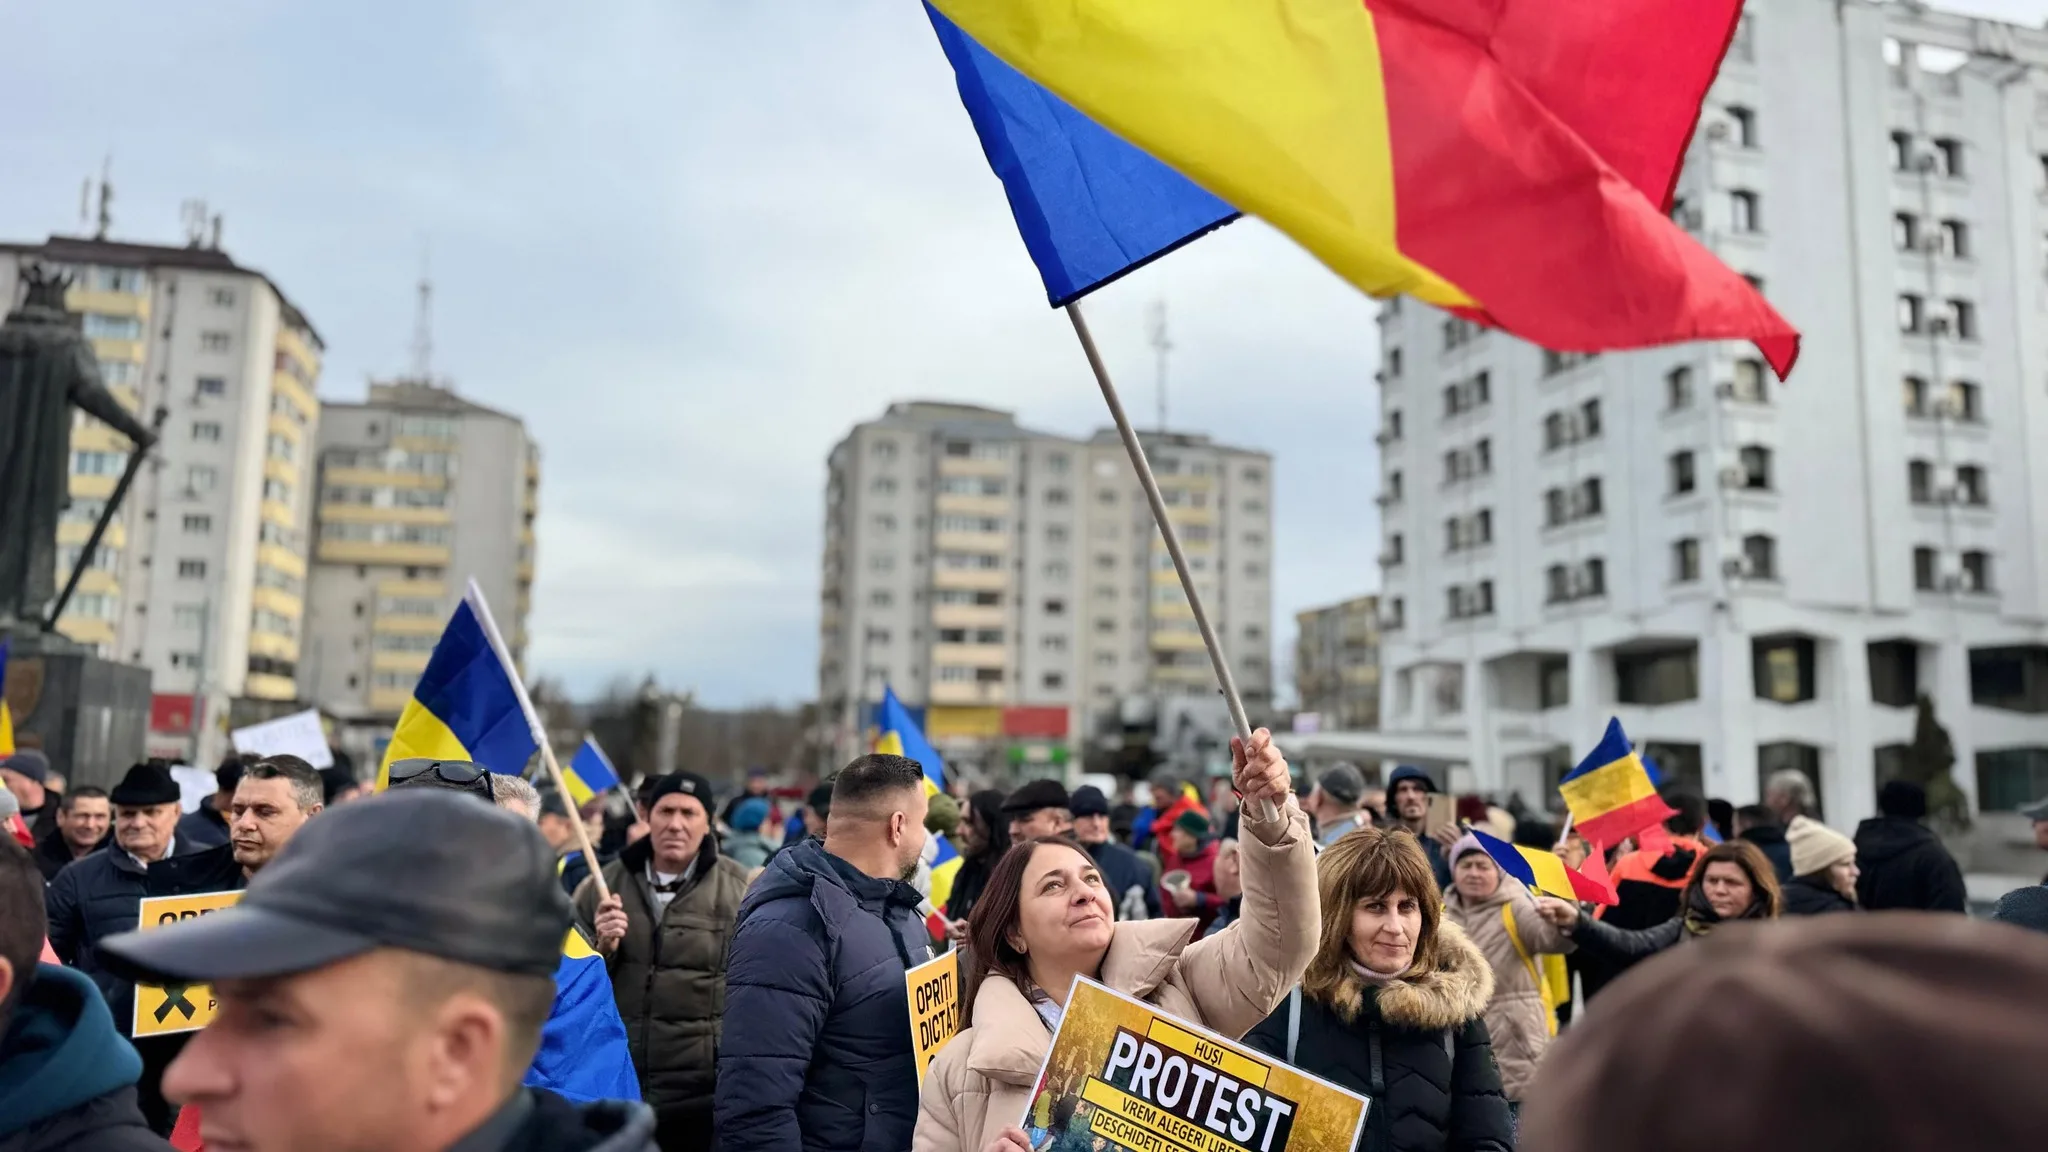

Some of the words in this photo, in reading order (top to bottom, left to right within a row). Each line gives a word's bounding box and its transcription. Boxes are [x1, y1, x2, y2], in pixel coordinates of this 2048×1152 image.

[920, 1001, 959, 1051] DICTAT
[1104, 1031, 1292, 1152] PROTEST
[1122, 1097, 1156, 1125] VREM
[1157, 1115, 1207, 1149] ALEGERI
